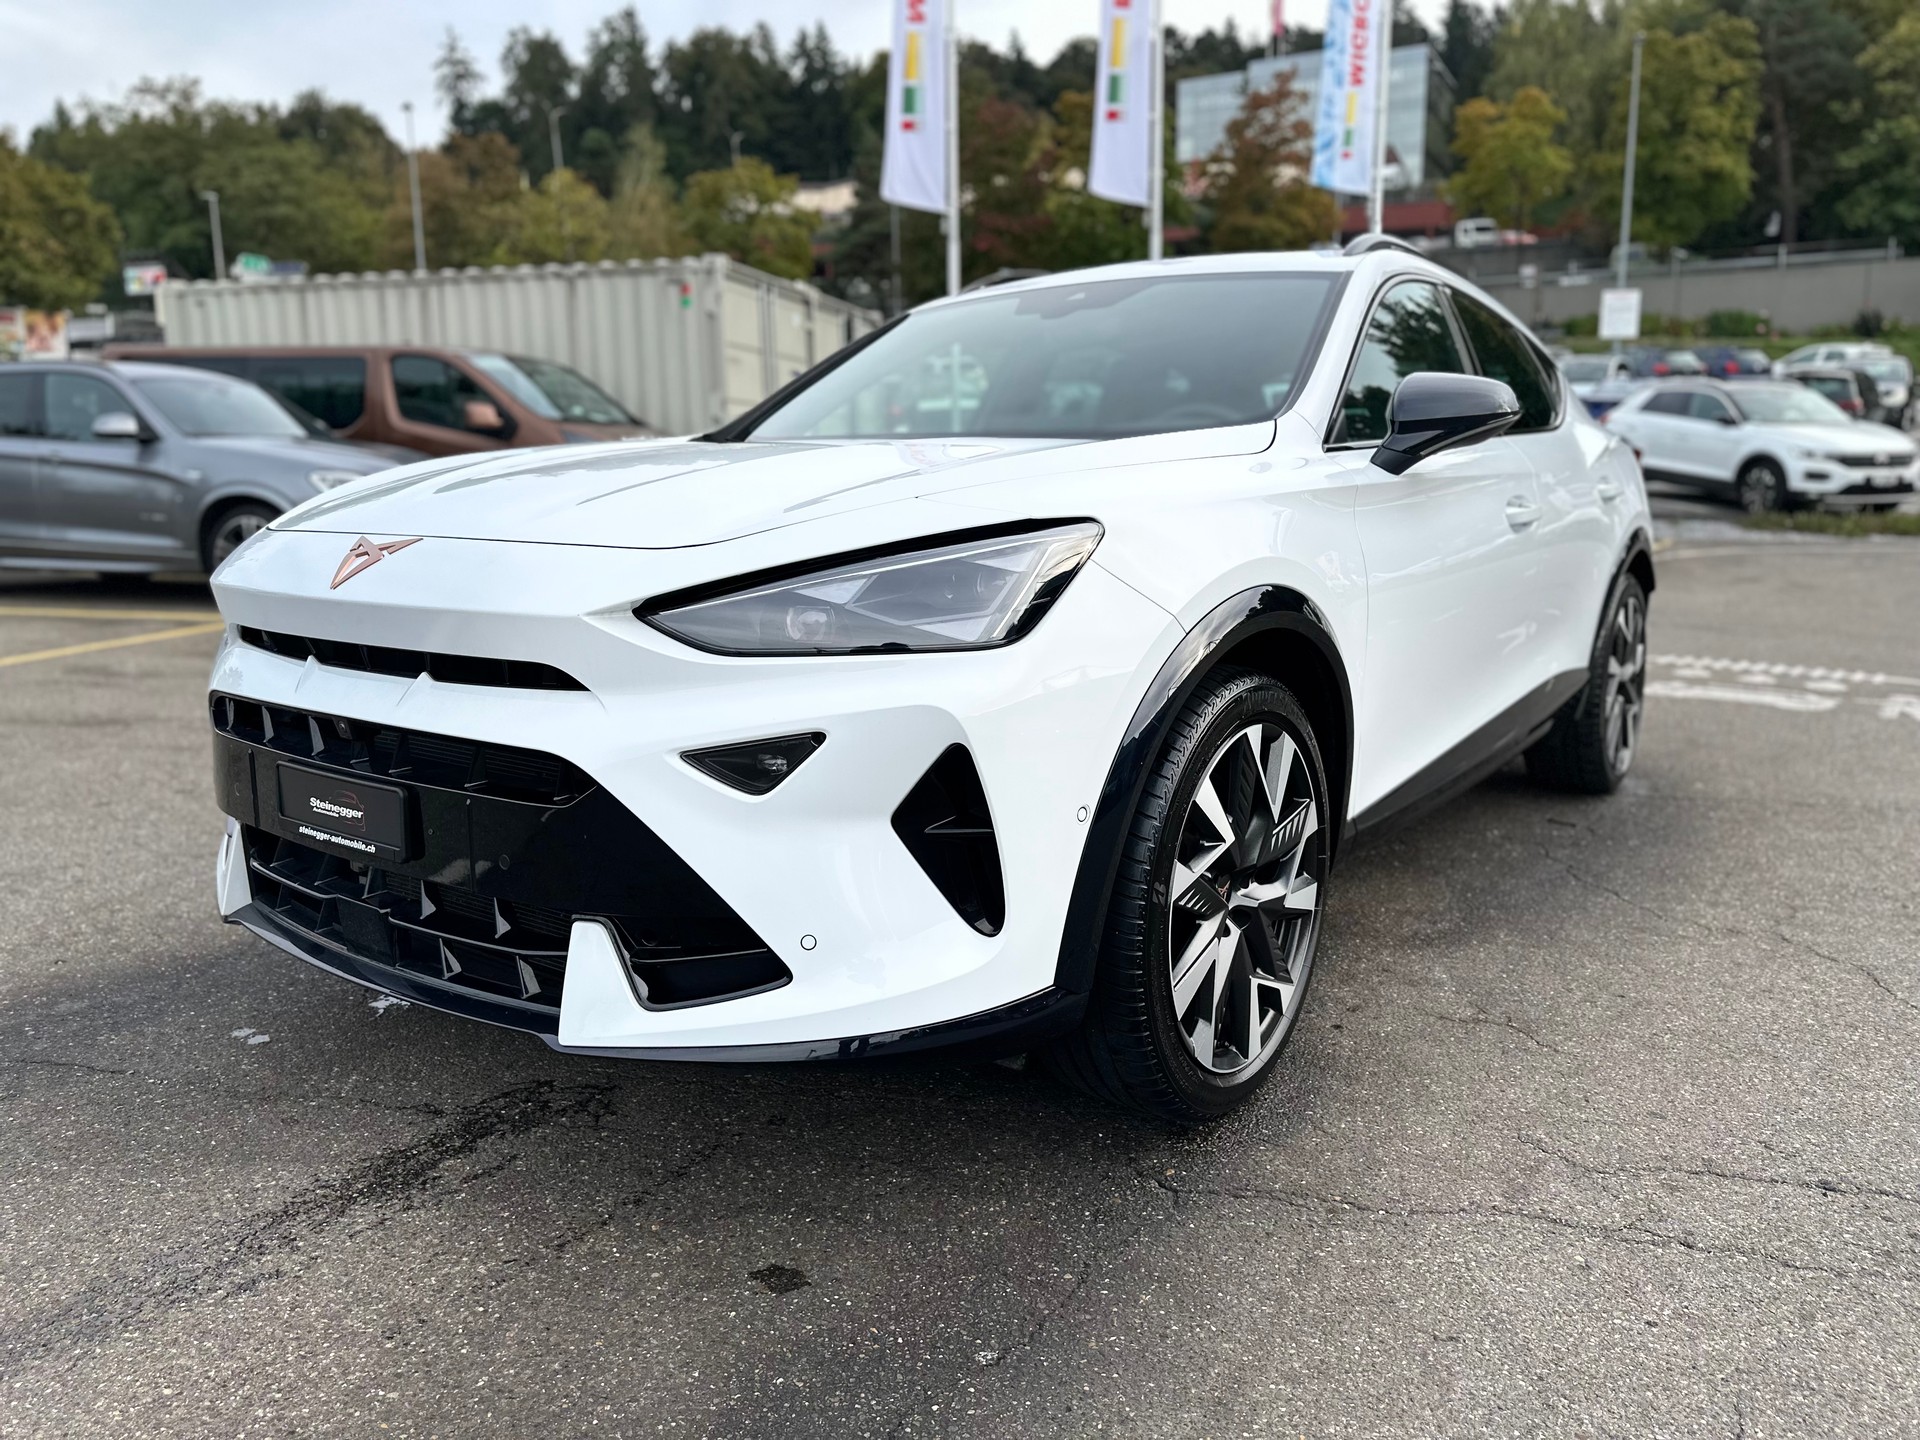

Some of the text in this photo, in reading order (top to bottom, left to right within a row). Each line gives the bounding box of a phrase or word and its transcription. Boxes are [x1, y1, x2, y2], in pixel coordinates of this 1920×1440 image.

[309, 797, 363, 818] Steinegger
[313, 807, 339, 817] Automobile
[299, 826, 375, 853] steinegger-automobile.ch
